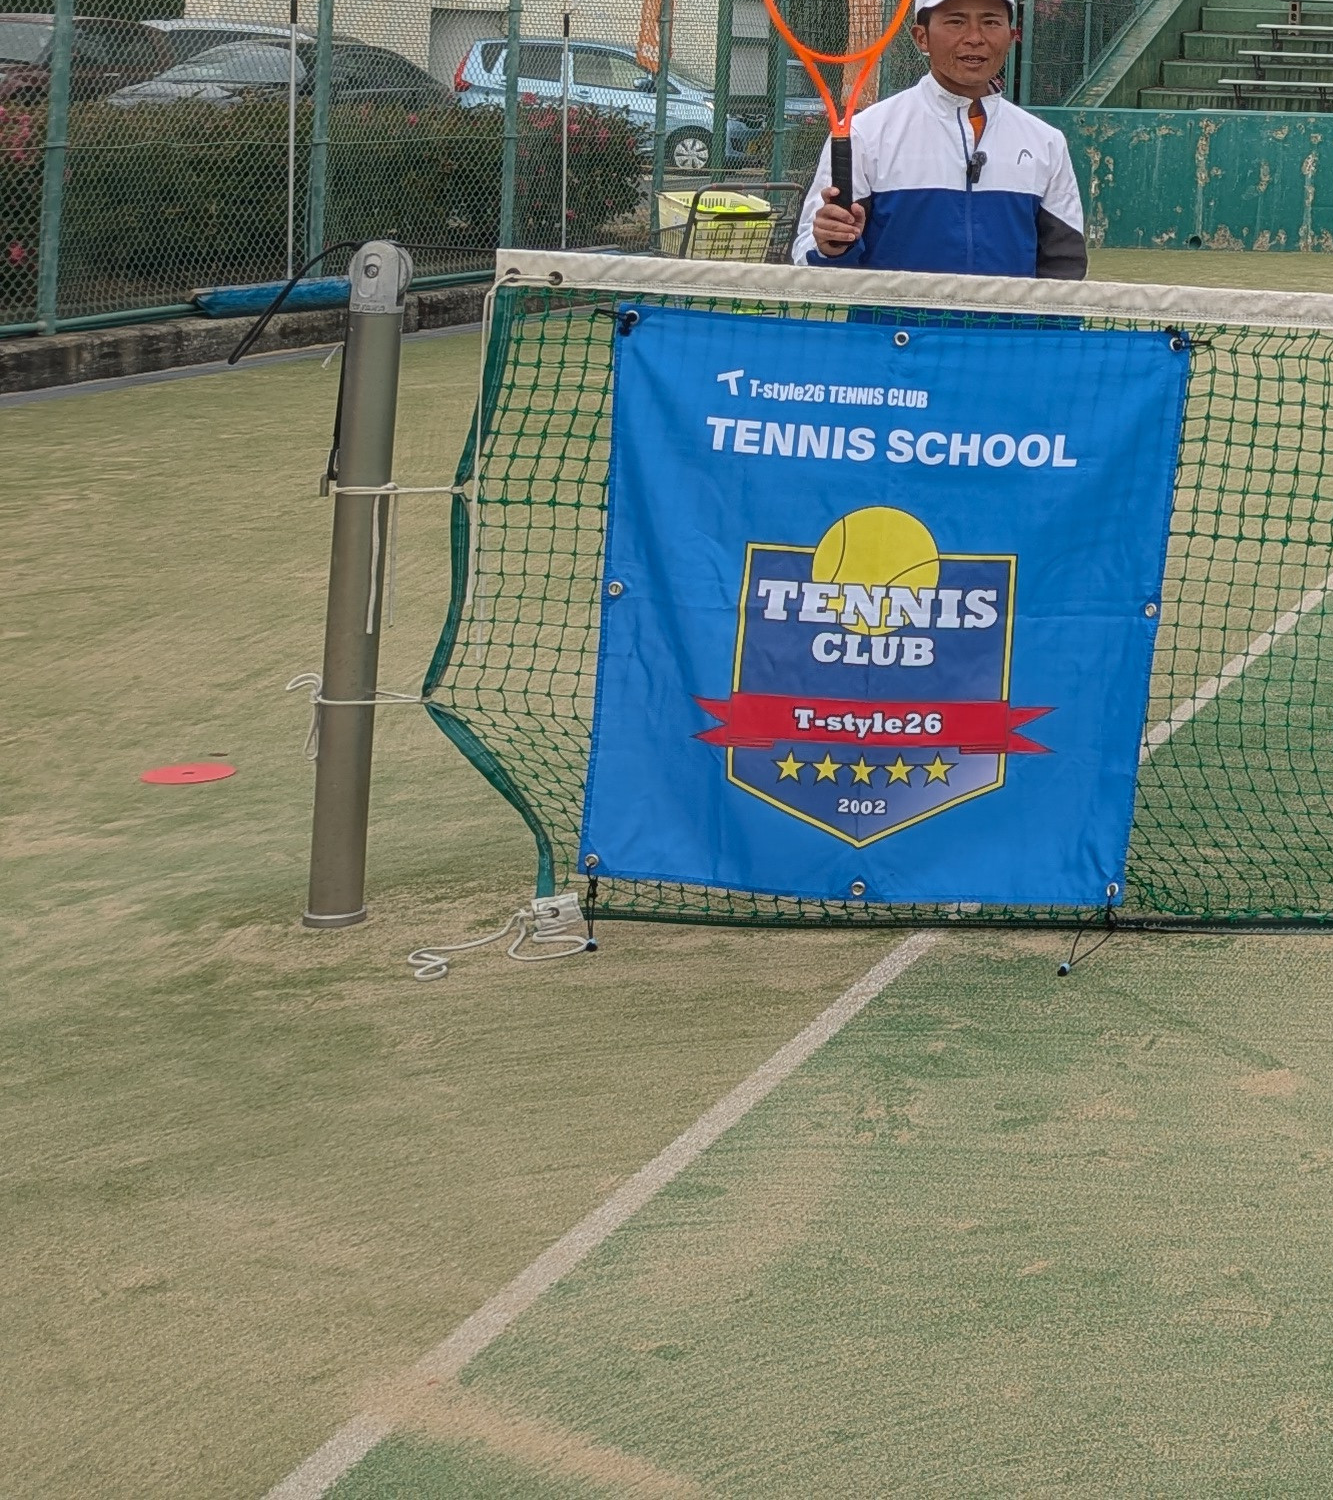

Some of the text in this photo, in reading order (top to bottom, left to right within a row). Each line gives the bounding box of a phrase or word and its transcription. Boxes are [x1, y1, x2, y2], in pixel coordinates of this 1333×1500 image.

[750, 379, 825, 403] T-style26
[829, 385, 884, 406] TENNIS
[887, 388, 928, 409] CLUB
[706, 416, 1078, 468] TENNIS SCHOOL
[757, 579, 999, 630] TENNIS
[811, 632, 935, 668] CLUB
[793, 707, 944, 739] T-style26
[837, 797, 888, 816] 2002
